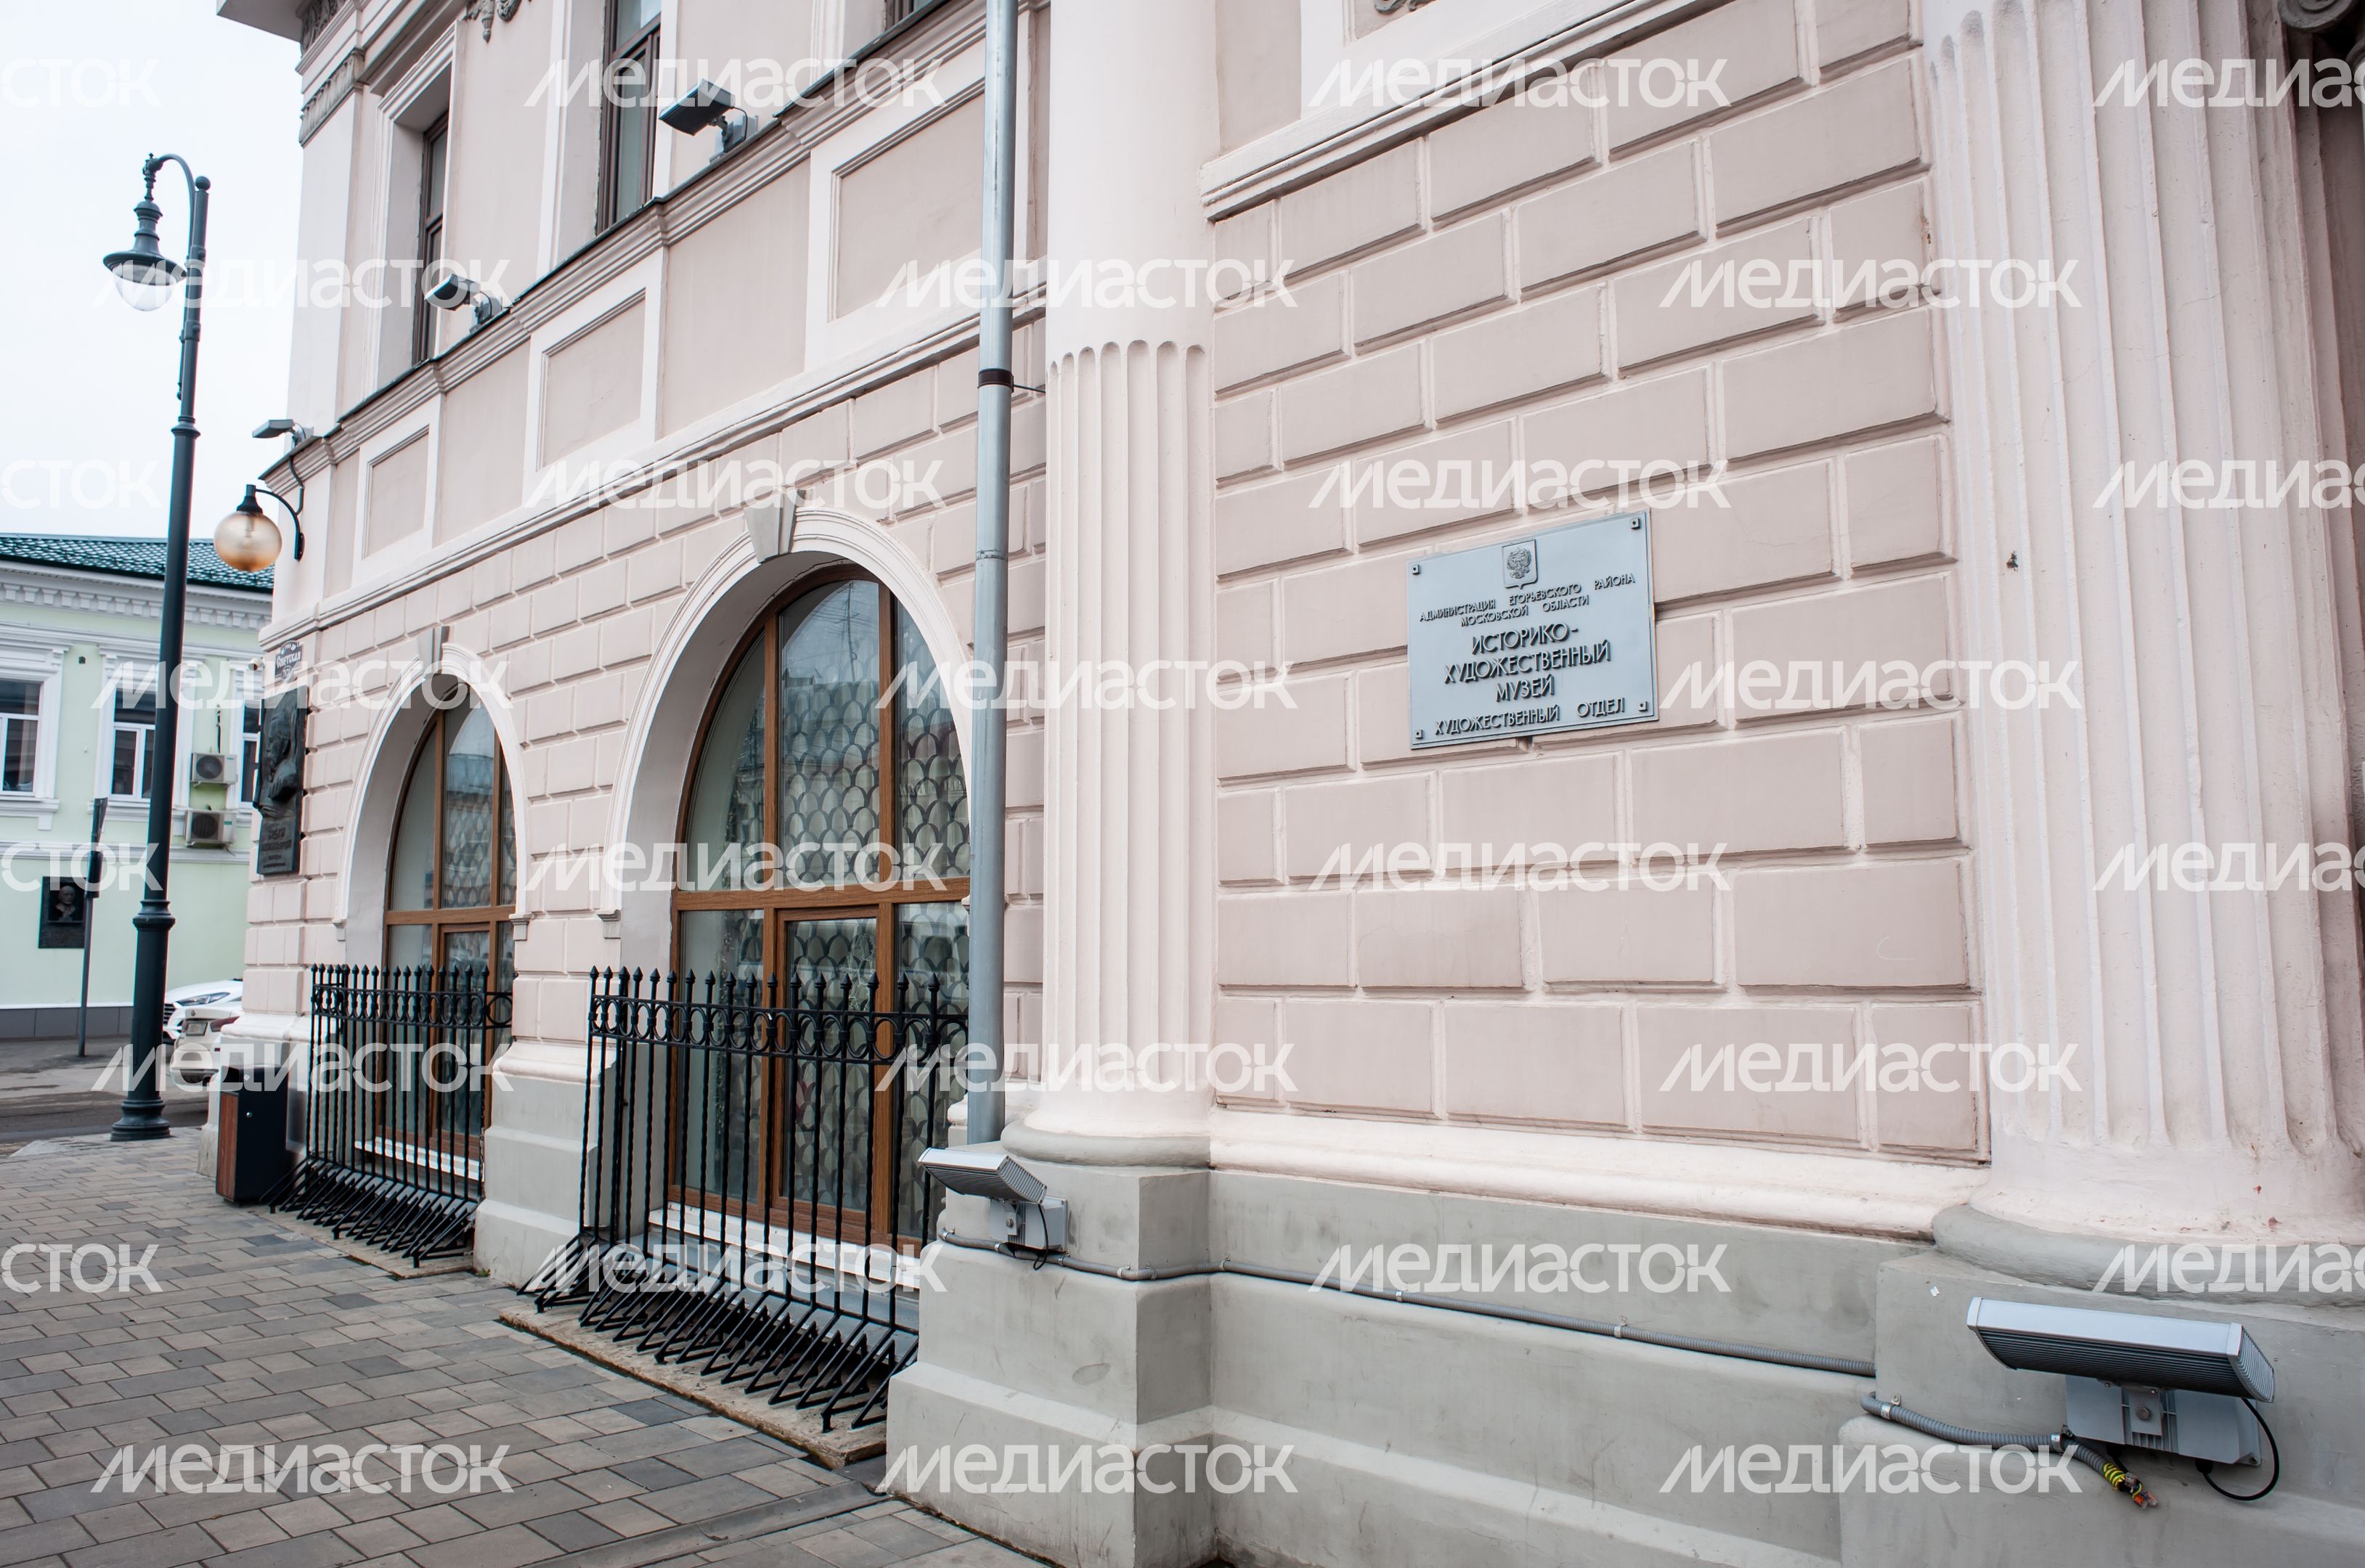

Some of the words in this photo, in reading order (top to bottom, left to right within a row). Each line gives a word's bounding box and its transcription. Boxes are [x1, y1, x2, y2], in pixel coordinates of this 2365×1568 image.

[1420, 599, 1496, 622] АДМИНИСТРАЦИЯ
[1508, 583, 1582, 606] ЕГОРЬЕВСКОГО
[1594, 572, 1635, 591] РАЙОНА
[1461, 605, 1529, 626] МОСКОВСКОЙ
[1542, 595, 1589, 613] ОБЛАСТИ
[1471, 622, 1579, 655] ИСТОРИКО-
[1444, 640, 1611, 685] ХУДОЖЕСТВЕННЫЙ
[1495, 674, 1555, 703] МУЗЕЙ
[1435, 704, 1560, 735] ХУДОЖЕСТВЕННЫЙ
[1576, 698, 1626, 719] ОТДЕЛ
